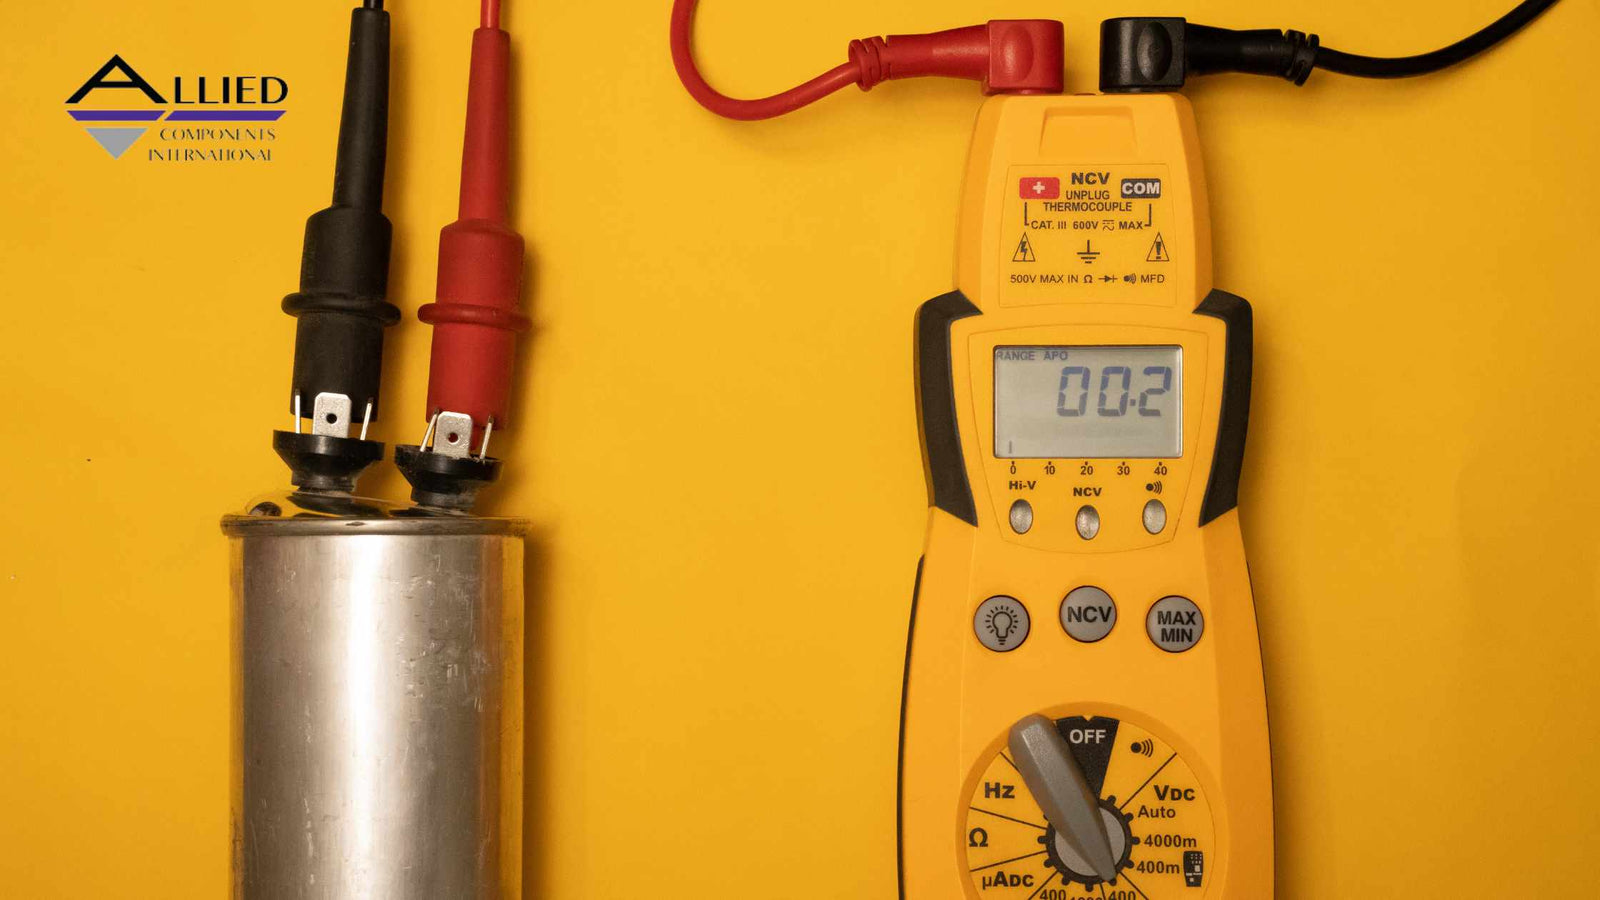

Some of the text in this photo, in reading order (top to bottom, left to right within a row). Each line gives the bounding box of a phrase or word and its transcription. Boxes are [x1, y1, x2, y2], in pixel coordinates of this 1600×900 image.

[1071, 172, 1110, 185] NCV
[1122, 181, 1161, 195] COM
[1066, 190, 1110, 200] UNPLUG
[1043, 201, 1132, 212] THERMOCOUPLE
[1031, 220, 1054, 230] CAT.
[1073, 220, 1099, 230] 600V
[1118, 221, 1143, 230] MAX
[1010, 274, 1037, 283] 500V
[1040, 274, 1064, 283] MAX
[1067, 274, 1078, 283] IN
[1140, 274, 1165, 283] MFD
[996, 351, 1069, 361] RANGE APO
[1056, 366, 1173, 417] 00.2
[1010, 465, 1168, 475] 0 10 20 30 40
[1008, 480, 1037, 490] Hi-V
[1073, 487, 1102, 497] NCV
[1067, 606, 1112, 623] NCV
[1157, 610, 1196, 626] MAX
[1161, 628, 1193, 642] MIN
[1069, 729, 1106, 744] OFF
[984, 782, 1016, 799] Hz
[1138, 805, 1176, 819] Auto
[1144, 834, 1197, 847] 4000m
[1137, 861, 1180, 875] 400m
[1040, 889, 1066, 900] 400
[1109, 891, 1136, 900] 400
